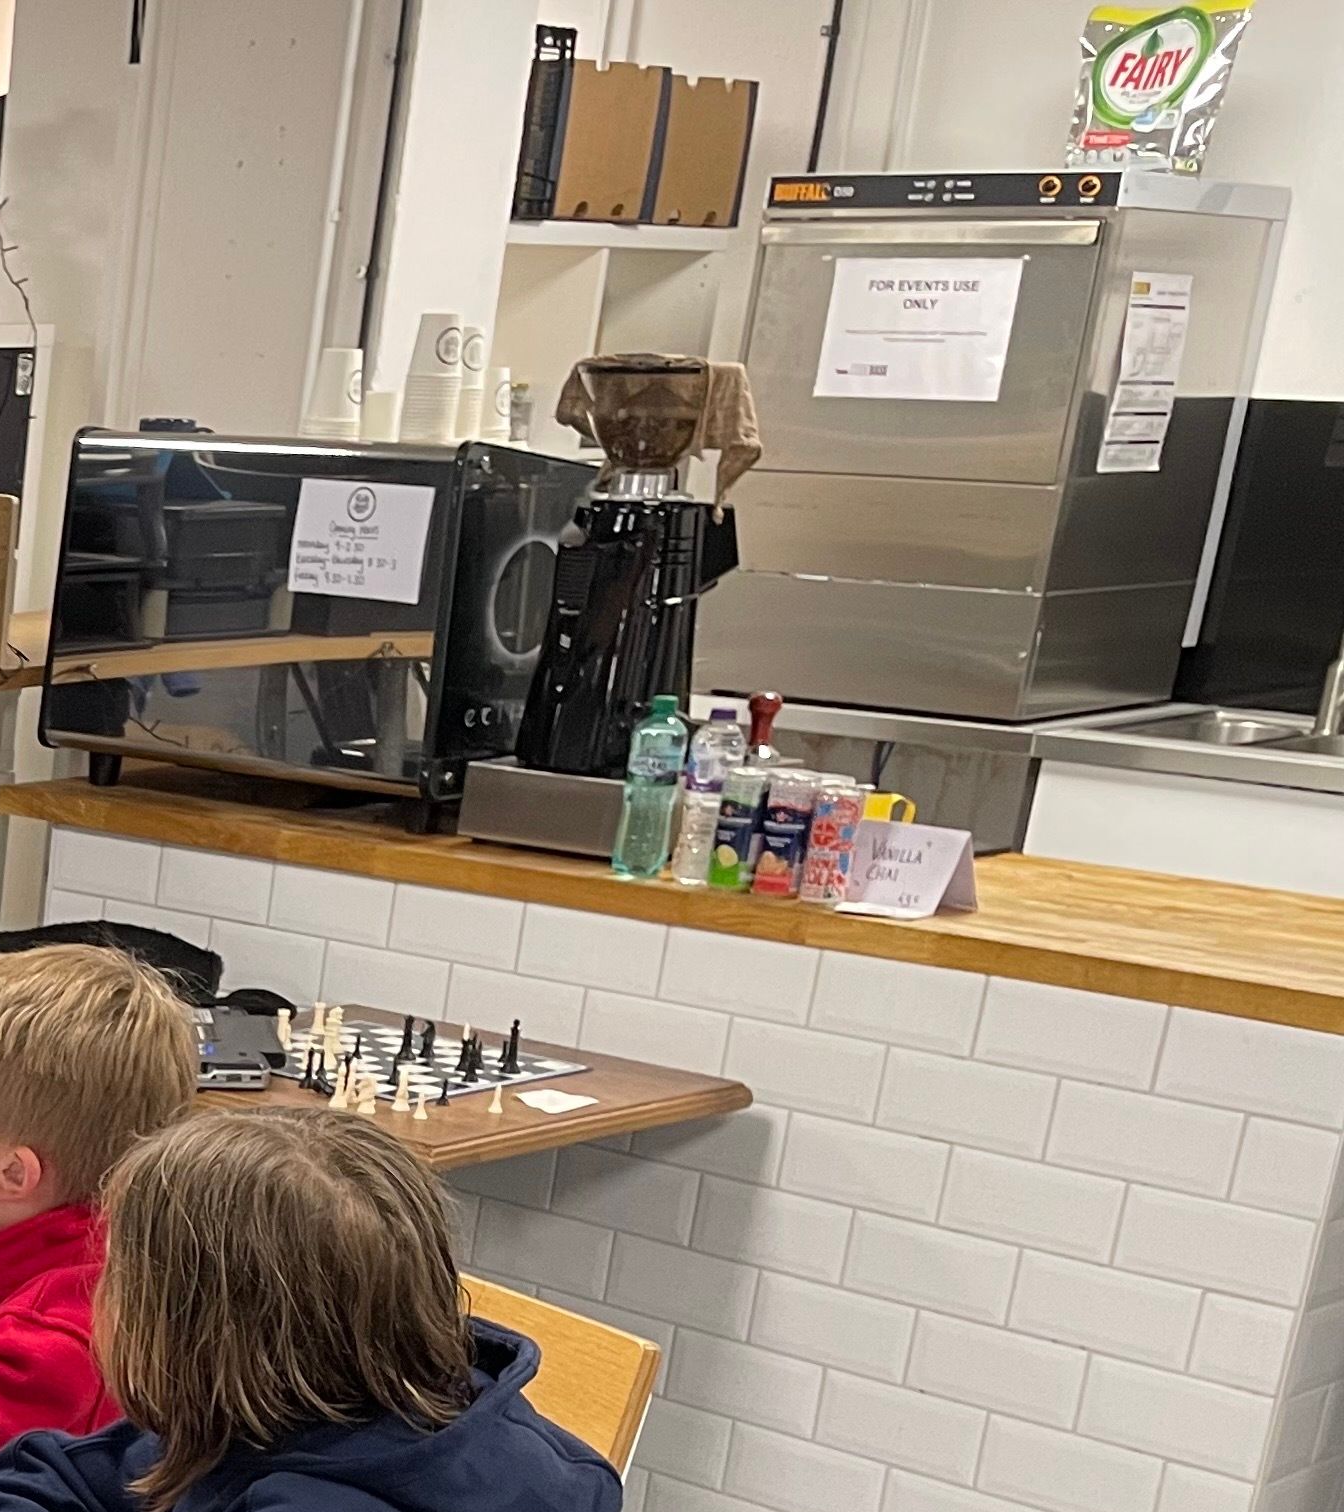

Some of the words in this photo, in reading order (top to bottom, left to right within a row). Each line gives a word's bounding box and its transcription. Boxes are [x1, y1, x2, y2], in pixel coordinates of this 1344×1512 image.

[1109, 46, 1195, 91] FAIRY
[868, 280, 895, 293] FOR
[898, 280, 950, 293] EVENTS
[953, 280, 980, 293] USE
[903, 298, 939, 310] ONLY
[872, 835, 923, 864] VANILLA
